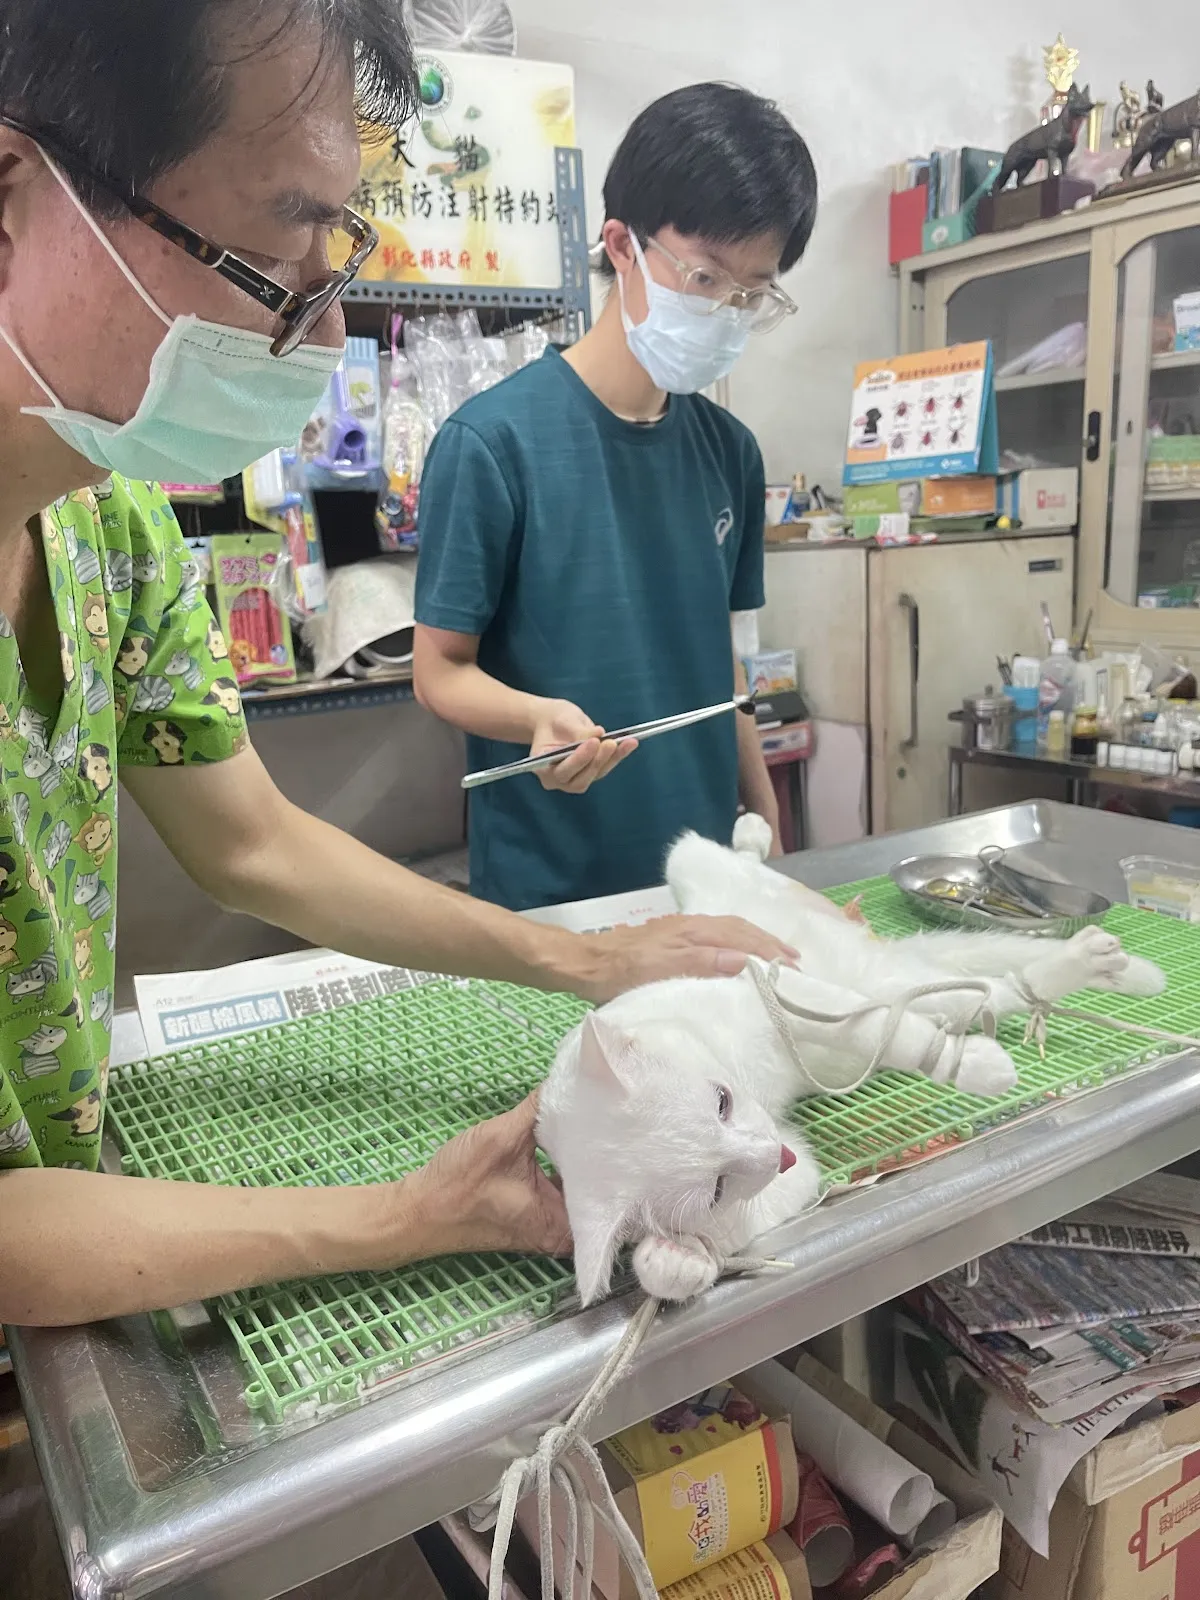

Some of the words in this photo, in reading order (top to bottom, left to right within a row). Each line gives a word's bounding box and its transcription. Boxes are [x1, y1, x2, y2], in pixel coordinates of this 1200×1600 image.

[382, 246, 473, 271] 彰化縣政府
